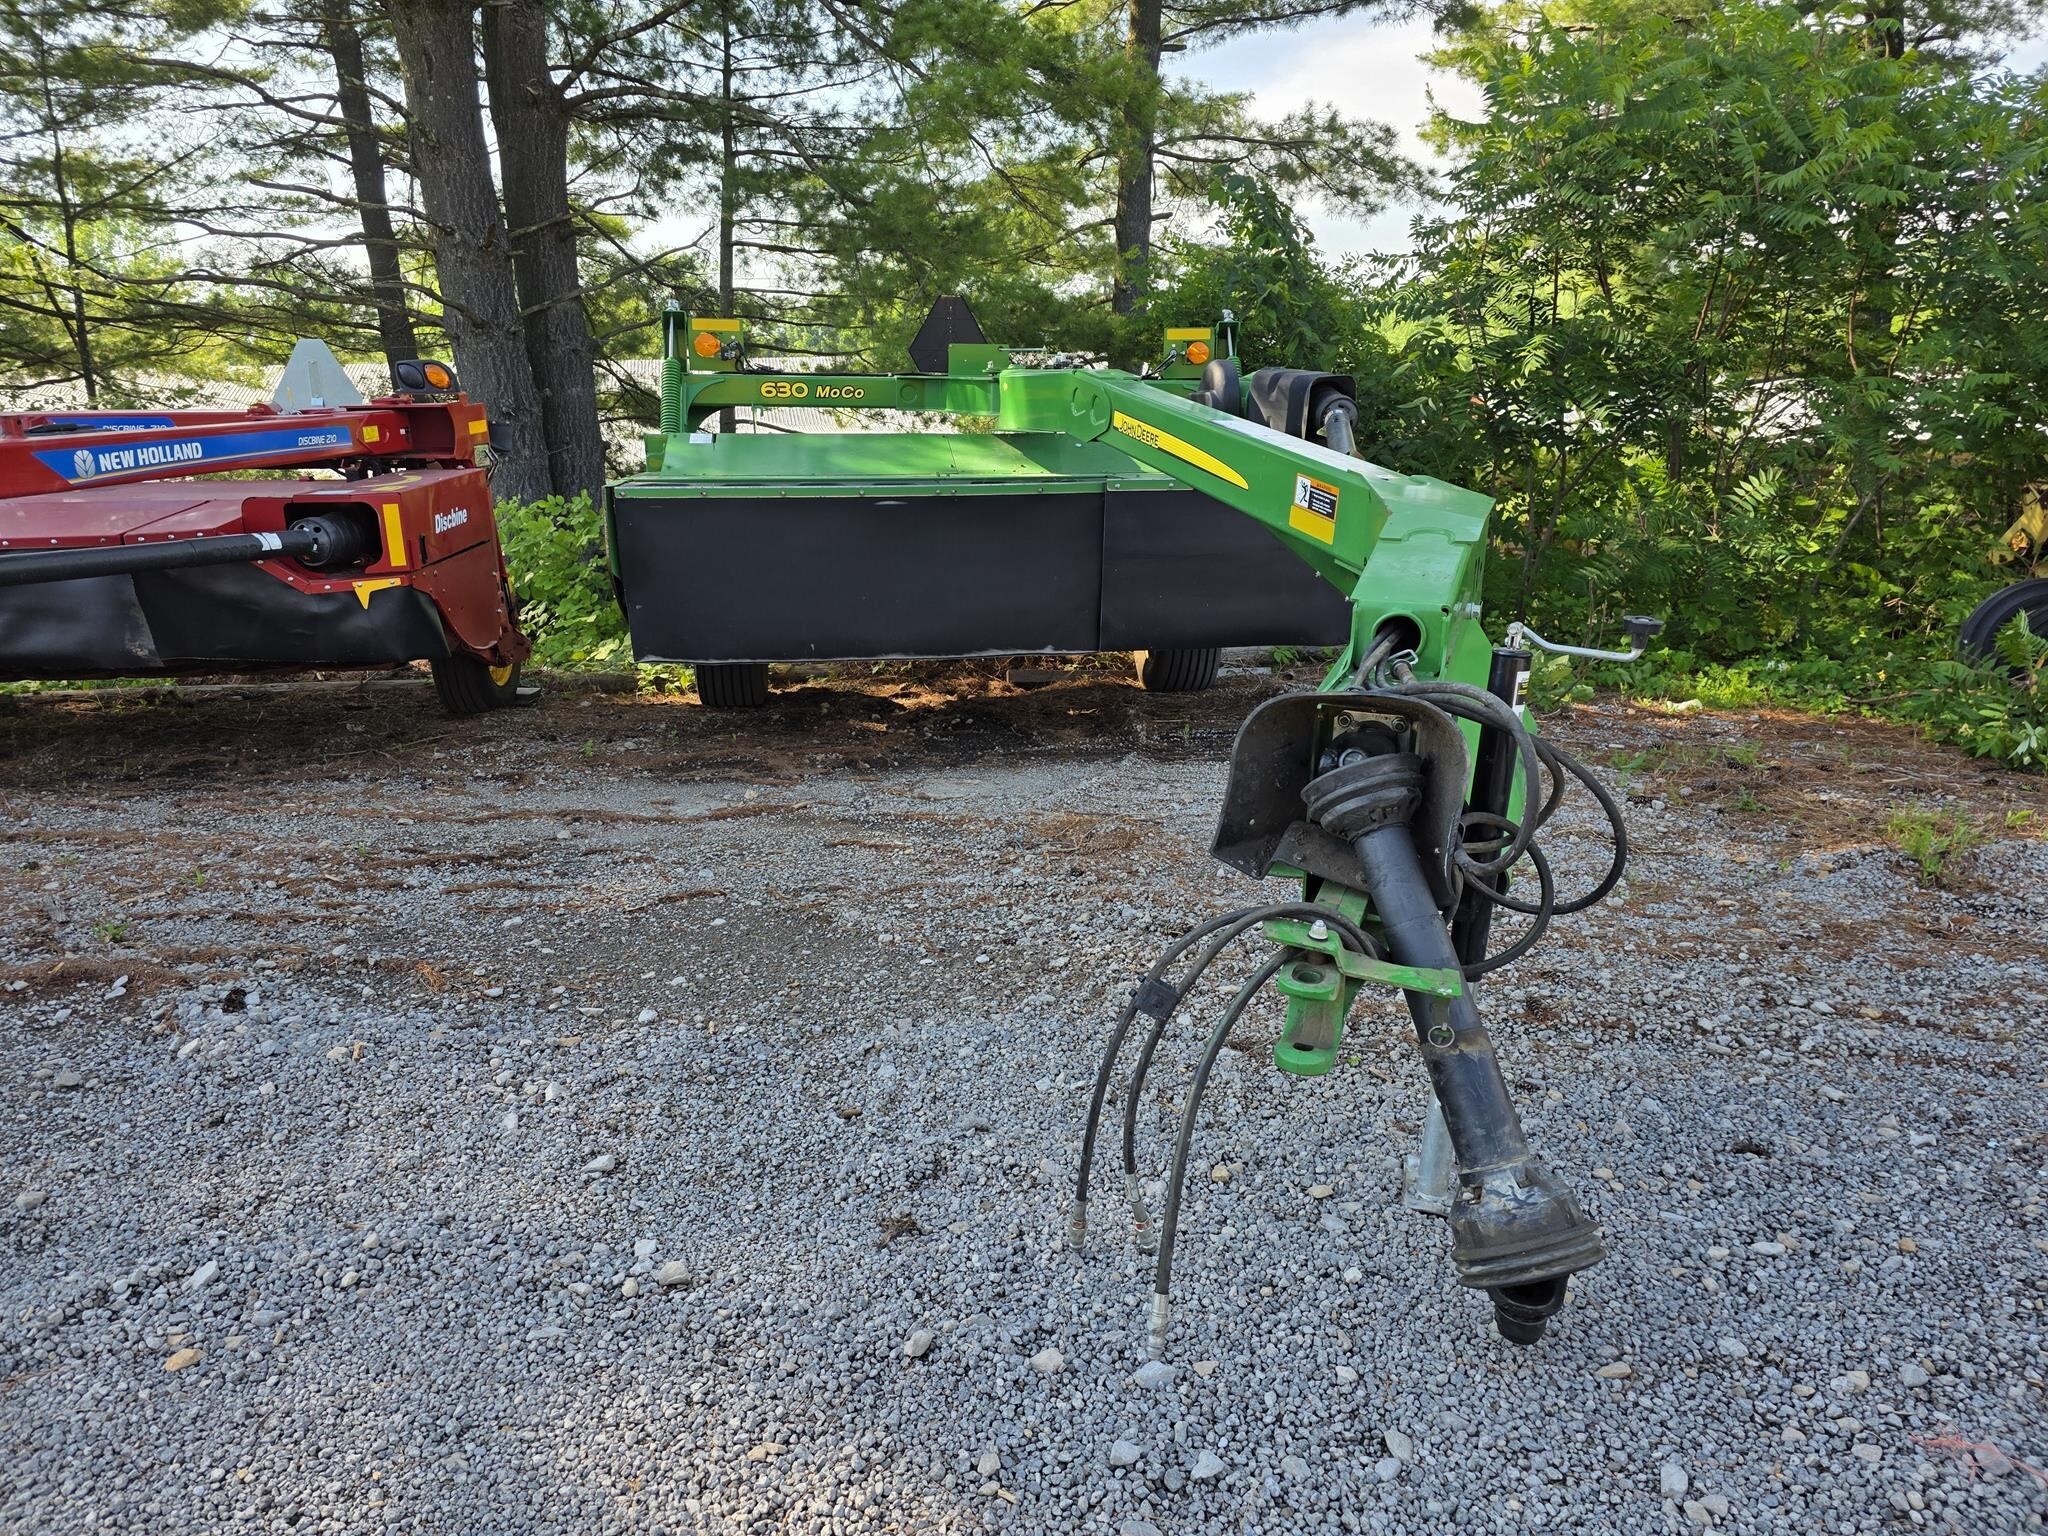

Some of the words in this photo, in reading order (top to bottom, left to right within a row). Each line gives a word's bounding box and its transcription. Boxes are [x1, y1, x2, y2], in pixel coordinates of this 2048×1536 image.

[760, 381, 809, 398] 630
[815, 385, 865, 399] MoCo
[298, 435, 325, 446] DISCBINE
[326, 434, 337, 444] 210
[98, 449, 135, 472] NEW
[137, 442, 203, 466] HOLLAND
[434, 506, 468, 534] Discbine
